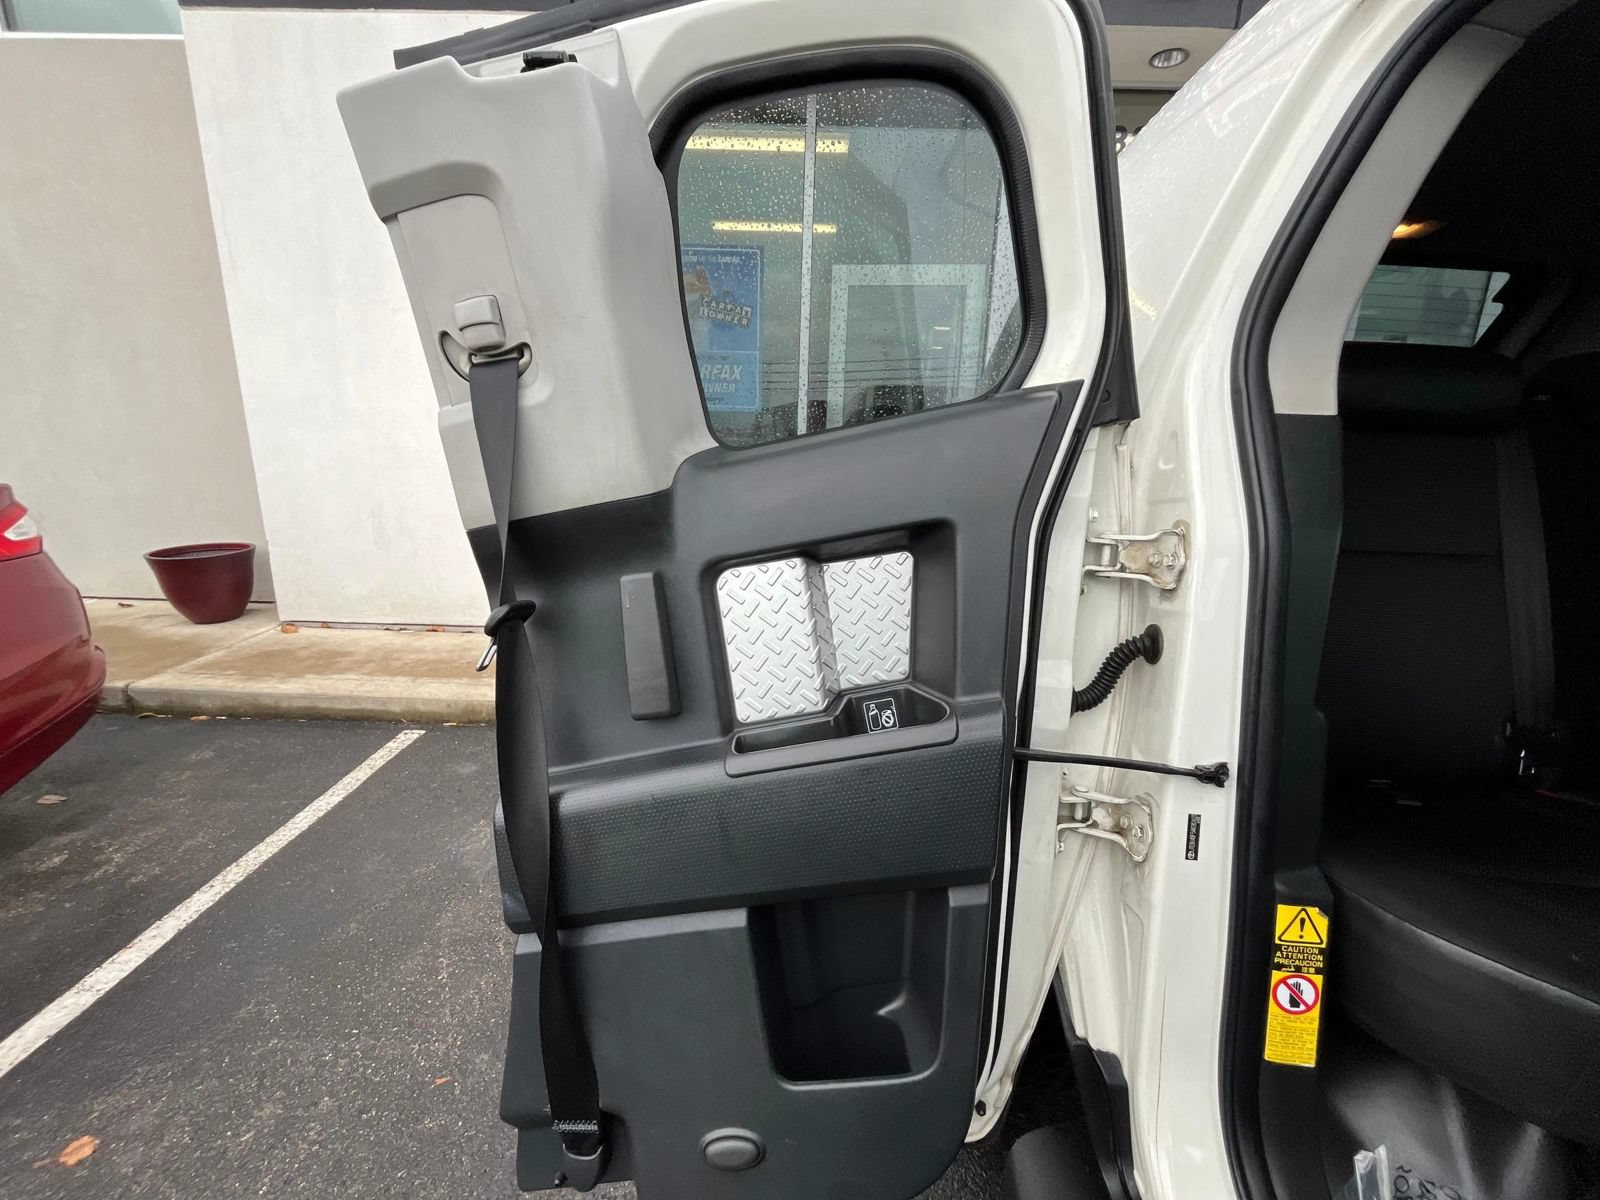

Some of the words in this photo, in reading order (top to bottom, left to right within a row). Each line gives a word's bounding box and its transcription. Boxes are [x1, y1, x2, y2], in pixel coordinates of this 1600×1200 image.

[701, 364, 742, 380] RFAX
[704, 382, 735, 394] WNER
[1281, 945, 1319, 954] CAUTION
[1275, 951, 1323, 961] ATTENTION
[1274, 957, 1324, 968] PRECAUCION
